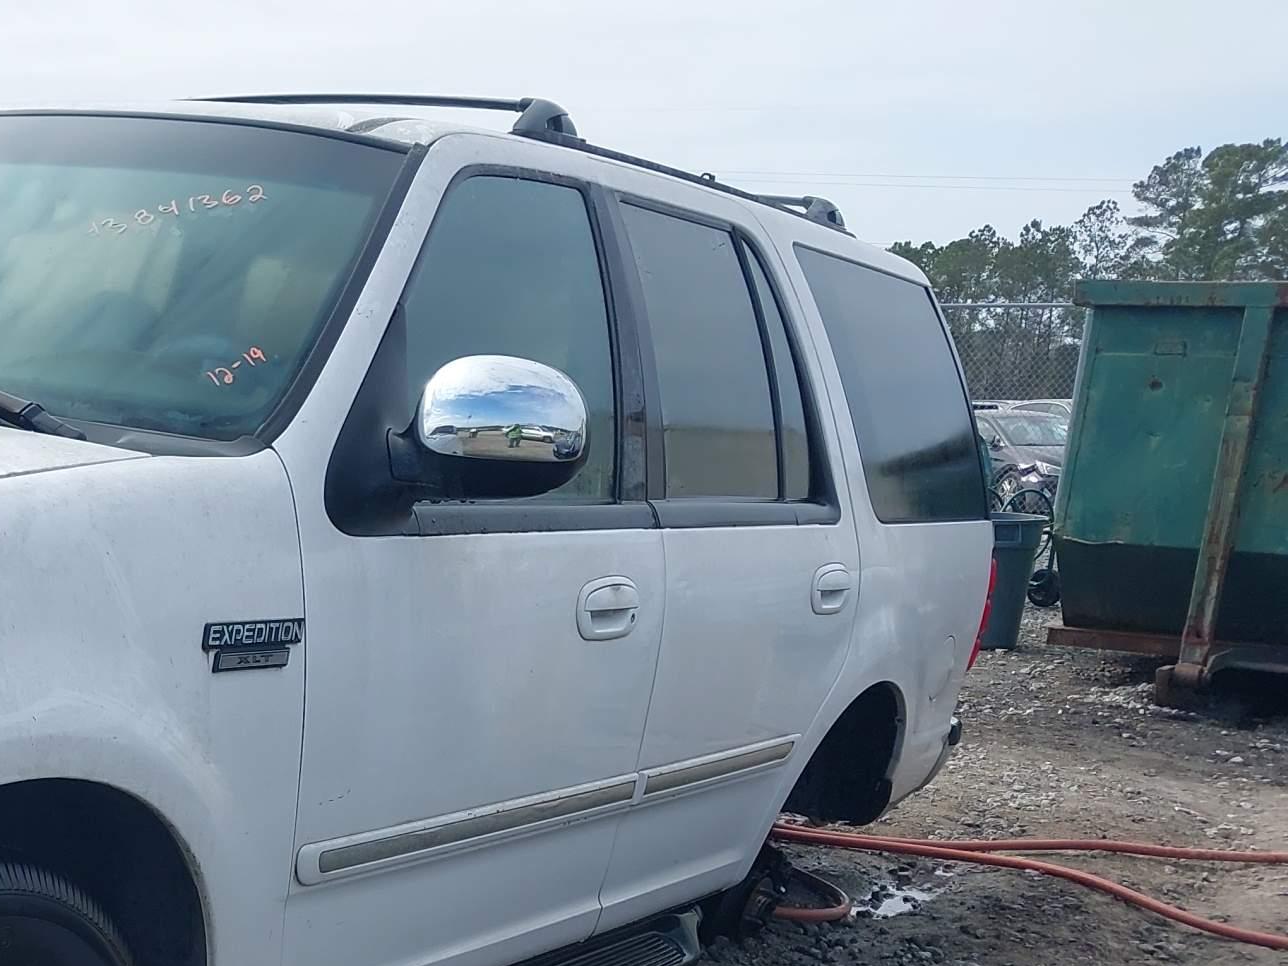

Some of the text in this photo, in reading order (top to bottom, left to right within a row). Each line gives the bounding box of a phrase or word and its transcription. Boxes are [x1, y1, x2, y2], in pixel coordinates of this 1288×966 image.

[206, 346, 267, 387] 12-19
[209, 621, 304, 646] EXPEDITION
[237, 654, 274, 665] XLT
